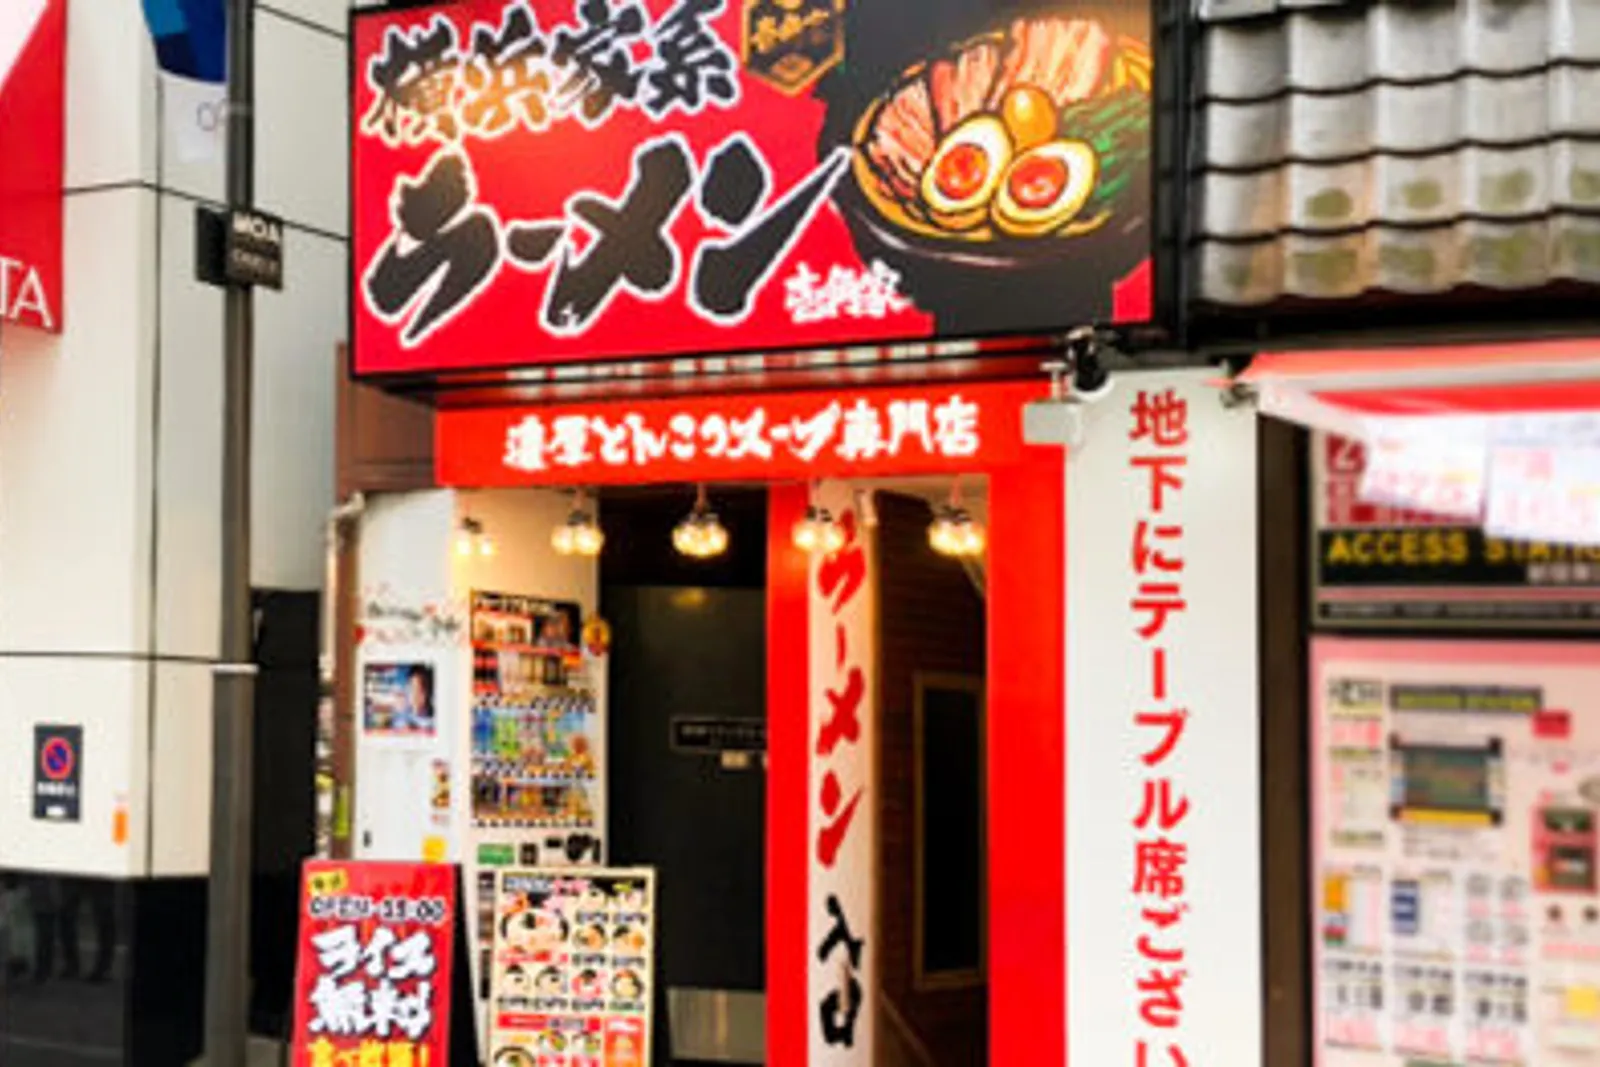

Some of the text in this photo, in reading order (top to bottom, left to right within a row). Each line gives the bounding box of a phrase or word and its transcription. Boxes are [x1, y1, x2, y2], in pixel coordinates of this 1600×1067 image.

[362, 132, 853, 348] ラーメン
[1327, 531, 1469, 565] ACCESS
